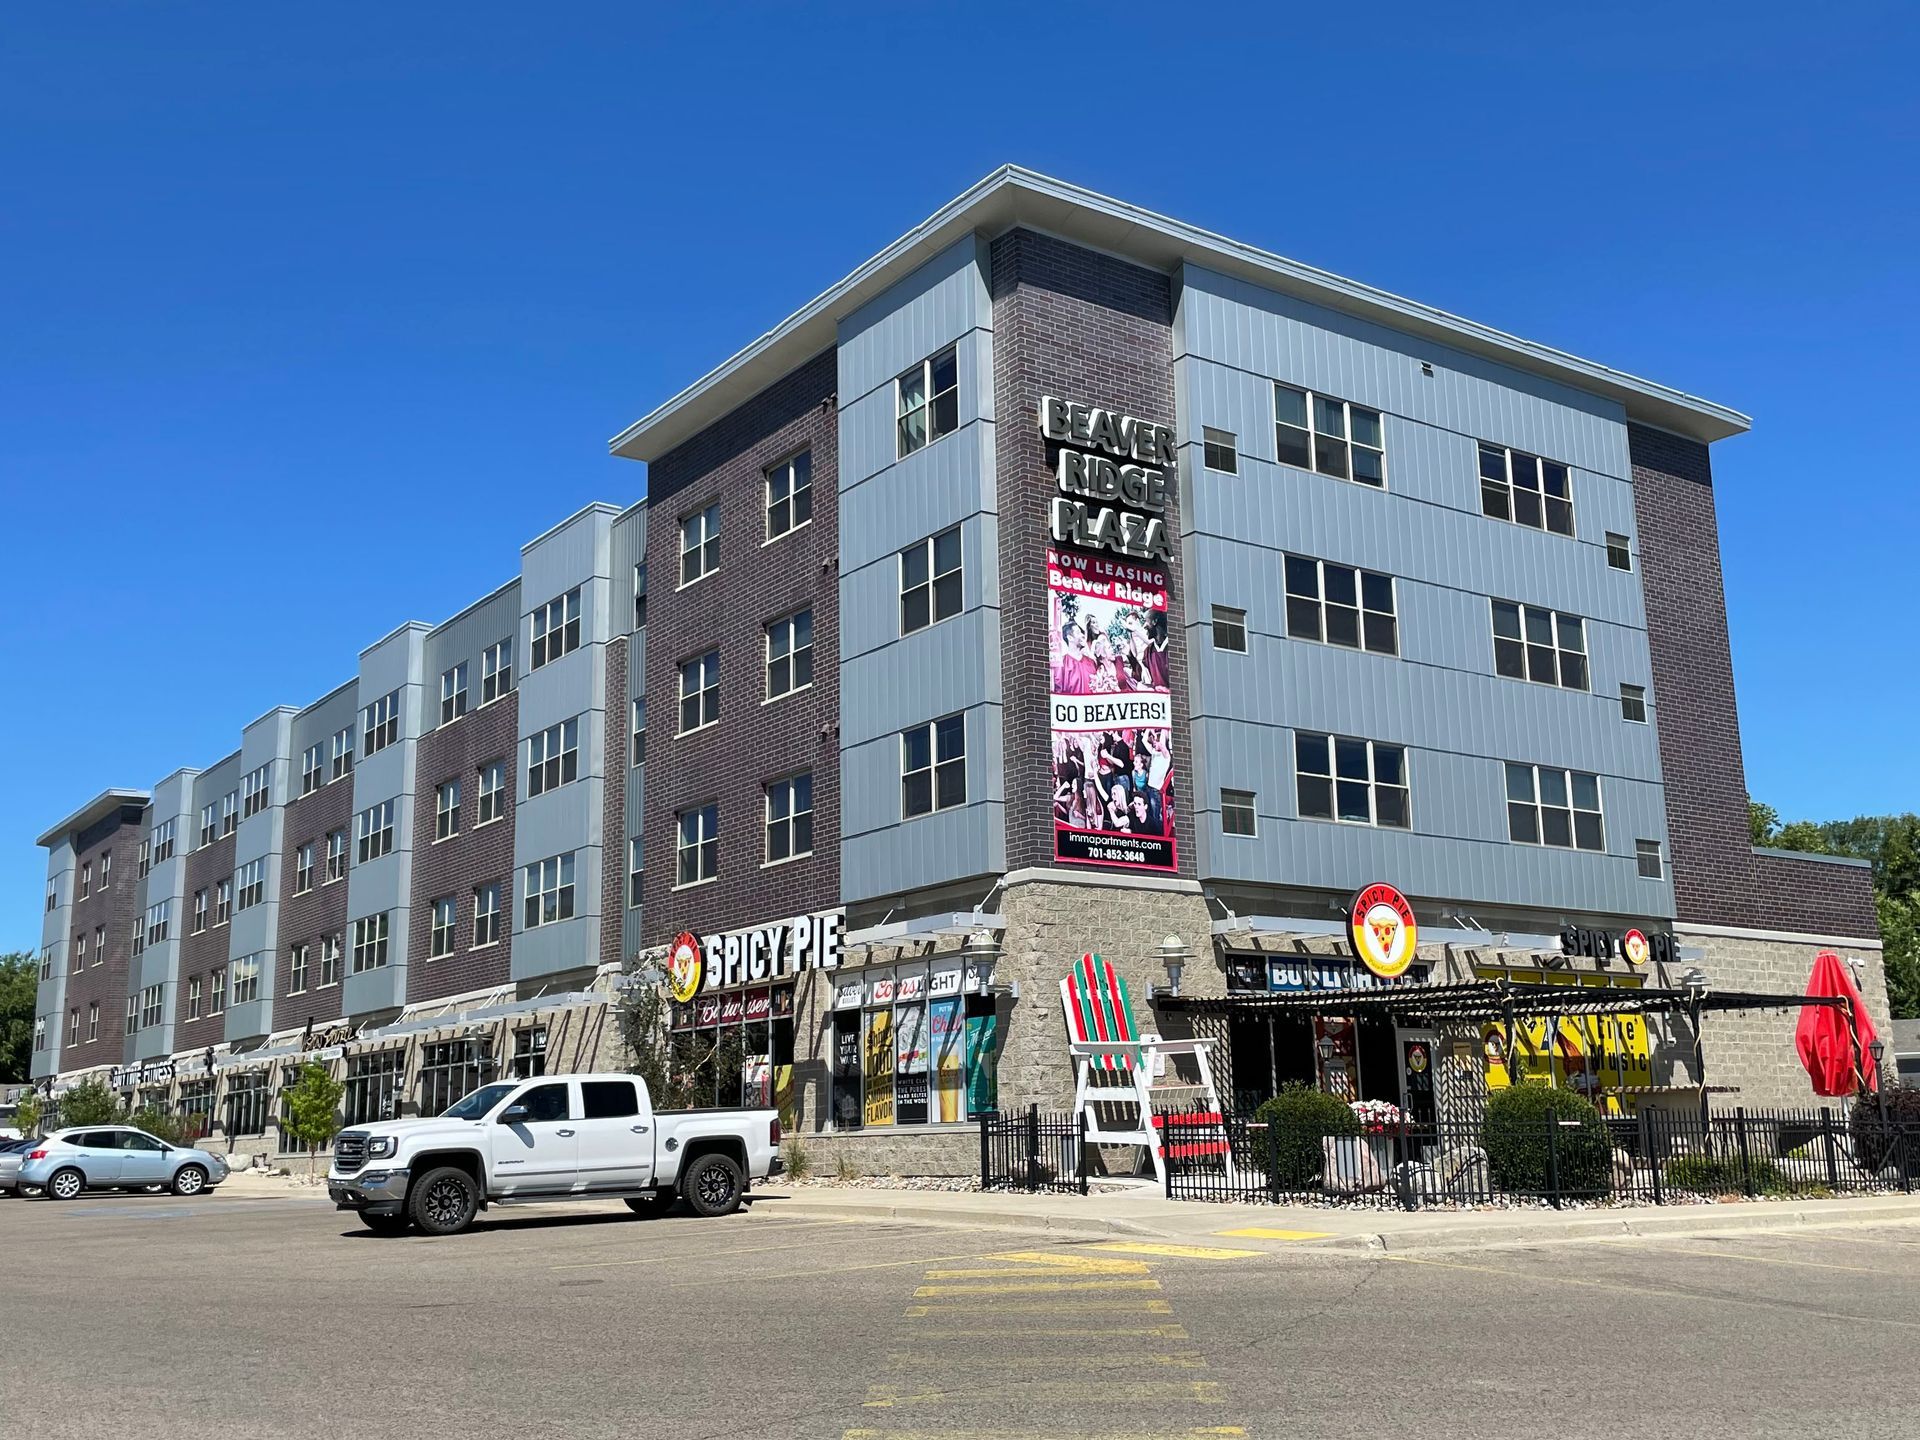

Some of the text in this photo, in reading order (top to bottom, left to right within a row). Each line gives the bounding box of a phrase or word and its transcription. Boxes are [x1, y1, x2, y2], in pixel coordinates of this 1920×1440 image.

[1043, 396, 1176, 467] BEAVER
[1059, 448, 1164, 512] RIDGE
[1053, 498, 1174, 562] PLAZA
[1049, 551, 1163, 586] NOW LEASING
[1049, 569, 1164, 608] Beaver Ridge
[1056, 702, 1166, 723] GO BEAVERS!
[1069, 832, 1162, 851] immapartments.com
[1088, 847, 1145, 862] 701-852-3648
[1357, 889, 1411, 919] SPICY PIE
[707, 925, 784, 987] SPICY
[793, 914, 840, 972] PIE
[1563, 928, 1616, 958] SPICY
[1652, 935, 1682, 962] PIE
[1272, 962, 1382, 989] BUD LIGH
[841, 1034, 855, 1044] LIVE
[1590, 1044, 1647, 1072] Music
[909, 1085, 927, 1093] PURES
[866, 1100, 894, 1124] FLAVOR
